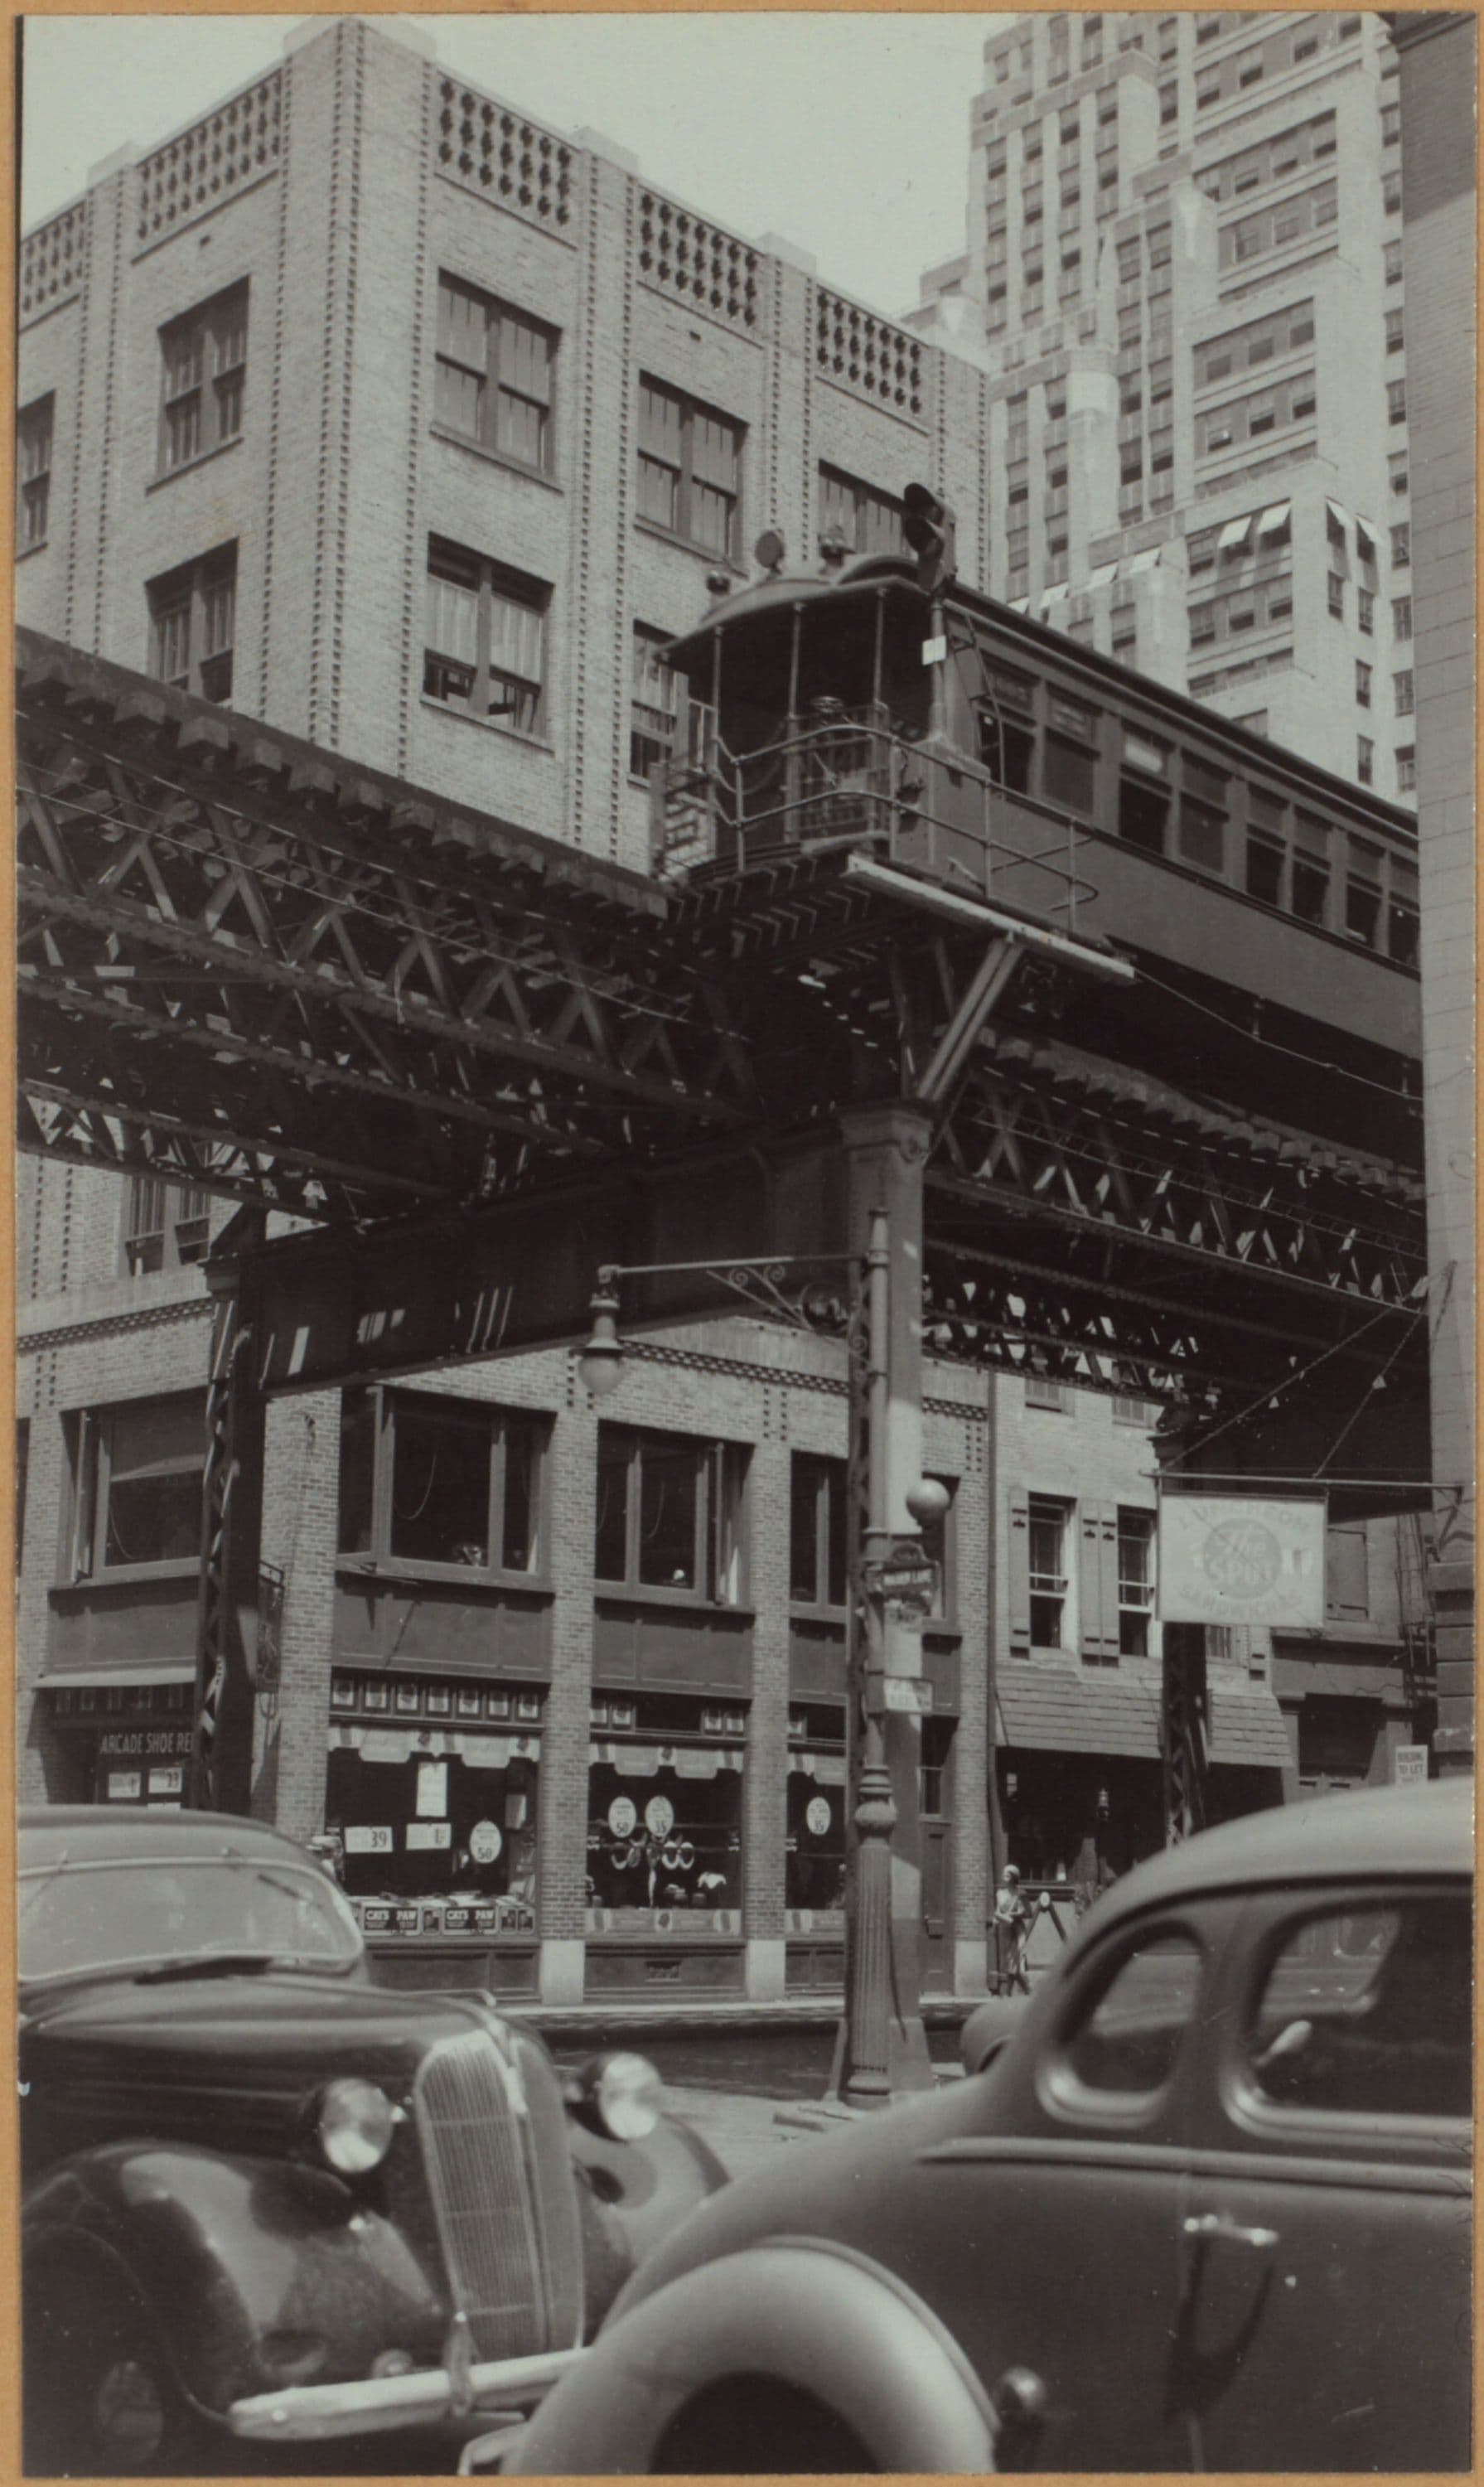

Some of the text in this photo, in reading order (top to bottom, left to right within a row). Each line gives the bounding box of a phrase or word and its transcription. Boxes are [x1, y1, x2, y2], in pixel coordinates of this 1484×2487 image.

[99, 1734, 143, 1754] ARCADE
[146, 1732, 173, 1754] SHOE
[1399, 1764, 1424, 1774] TO LET
[371, 1831, 387, 1848] 39
[396, 1909, 418, 1920] PAW
[475, 1909, 495, 1920] PAW
